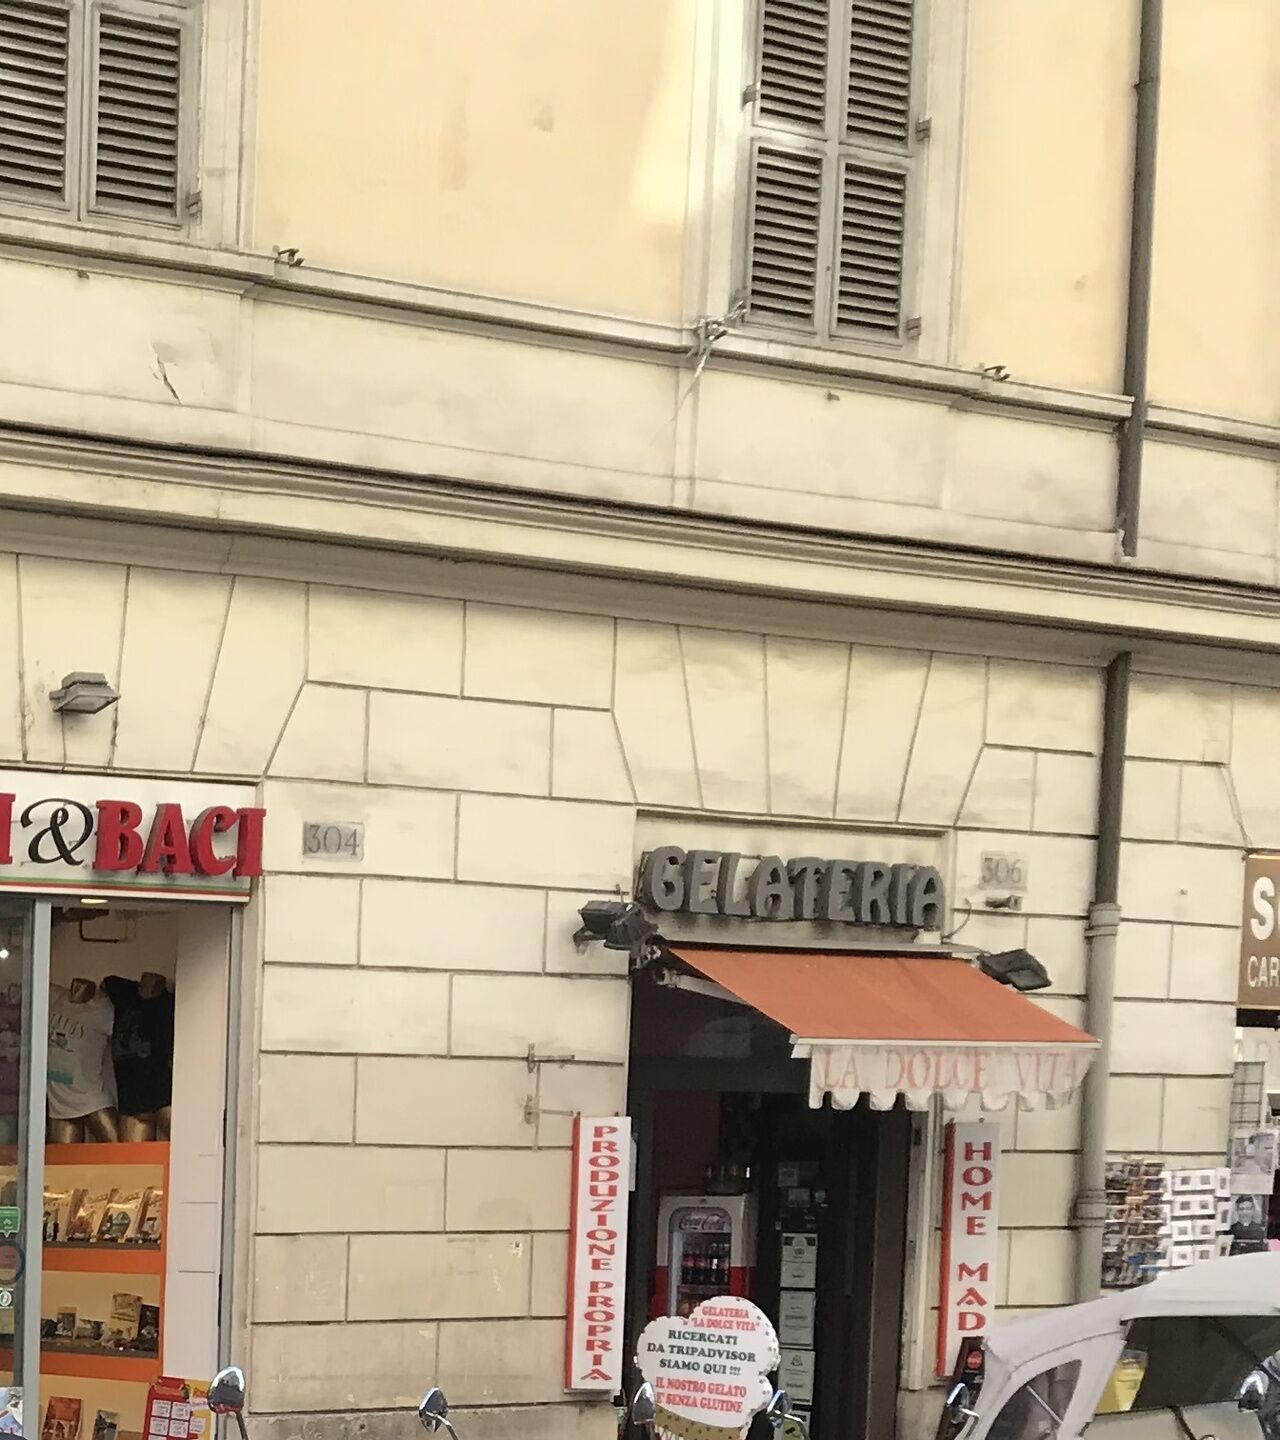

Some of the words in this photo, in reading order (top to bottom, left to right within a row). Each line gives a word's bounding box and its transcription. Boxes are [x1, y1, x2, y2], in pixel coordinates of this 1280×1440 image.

[20, 798, 94, 866] &
[92, 800, 266, 877] BACI
[308, 824, 360, 856] 304
[644, 845, 943, 927] GELATERIA
[1250, 875, 1280, 942] S
[823, 1050, 860, 1088] LA
[886, 1050, 992, 1090] DOLCE
[586, 1126, 620, 1271] PRODUZIONE
[961, 1141, 993, 1236] HOME
[702, 1306, 749, 1319] GELATERIA
[956, 1262, 989, 1331] MAD
[580, 1281, 616, 1381] PROPRIA
[668, 1330, 738, 1345] RICERCATI
[706, 1319, 734, 1328] DOLCE
[647, 1343, 666, 1354] DA
[668, 1345, 756, 1362] TRIPADVISOR
[659, 1359, 701, 1371] SIAMO
[703, 1363, 727, 1375] QUI
[655, 1376, 666, 1387] IL
[666, 1377, 706, 1393] NOSTRO
[708, 1383, 747, 1398] GELATO
[666, 1393, 698, 1406] SENZA
[700, 1399, 743, 1413] GLUTINE
